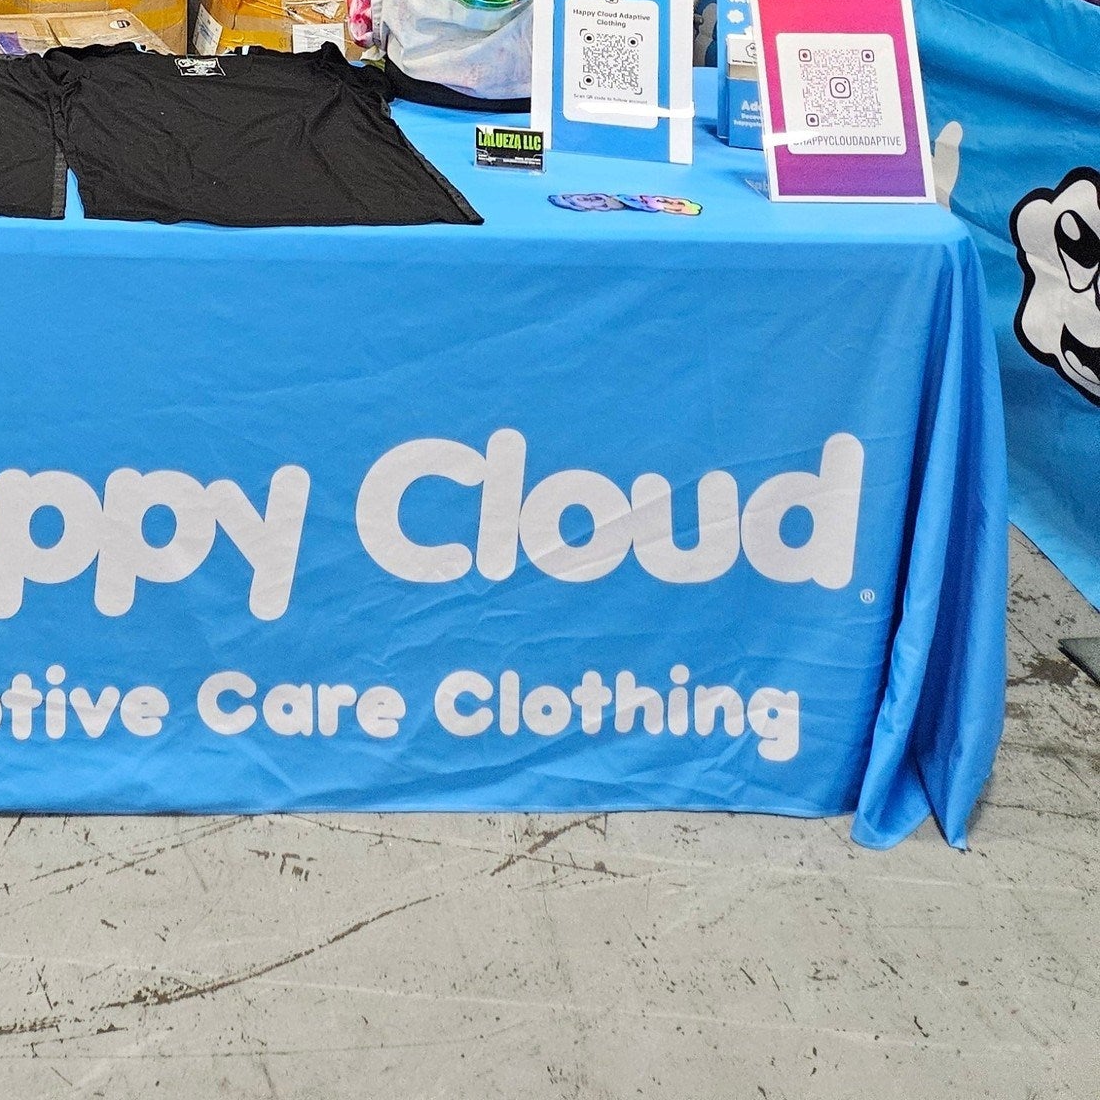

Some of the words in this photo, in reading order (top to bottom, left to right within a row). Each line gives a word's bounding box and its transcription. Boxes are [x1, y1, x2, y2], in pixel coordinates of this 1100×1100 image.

[573, 8, 595, 17] Happy
[597, 10, 617, 18] Cloud
[619, 12, 650, 21] Adaptive
[597, 19, 626, 29] Clothing
[478, 131, 522, 150] LALUEZA
[523, 134, 541, 150] LLC
[793, 135, 901, 147] APPYCLOUDADAPTIVE
[356, 428, 865, 589] Cloud
[197, 671, 406, 738] Care
[434, 665, 800, 762] Clothing
